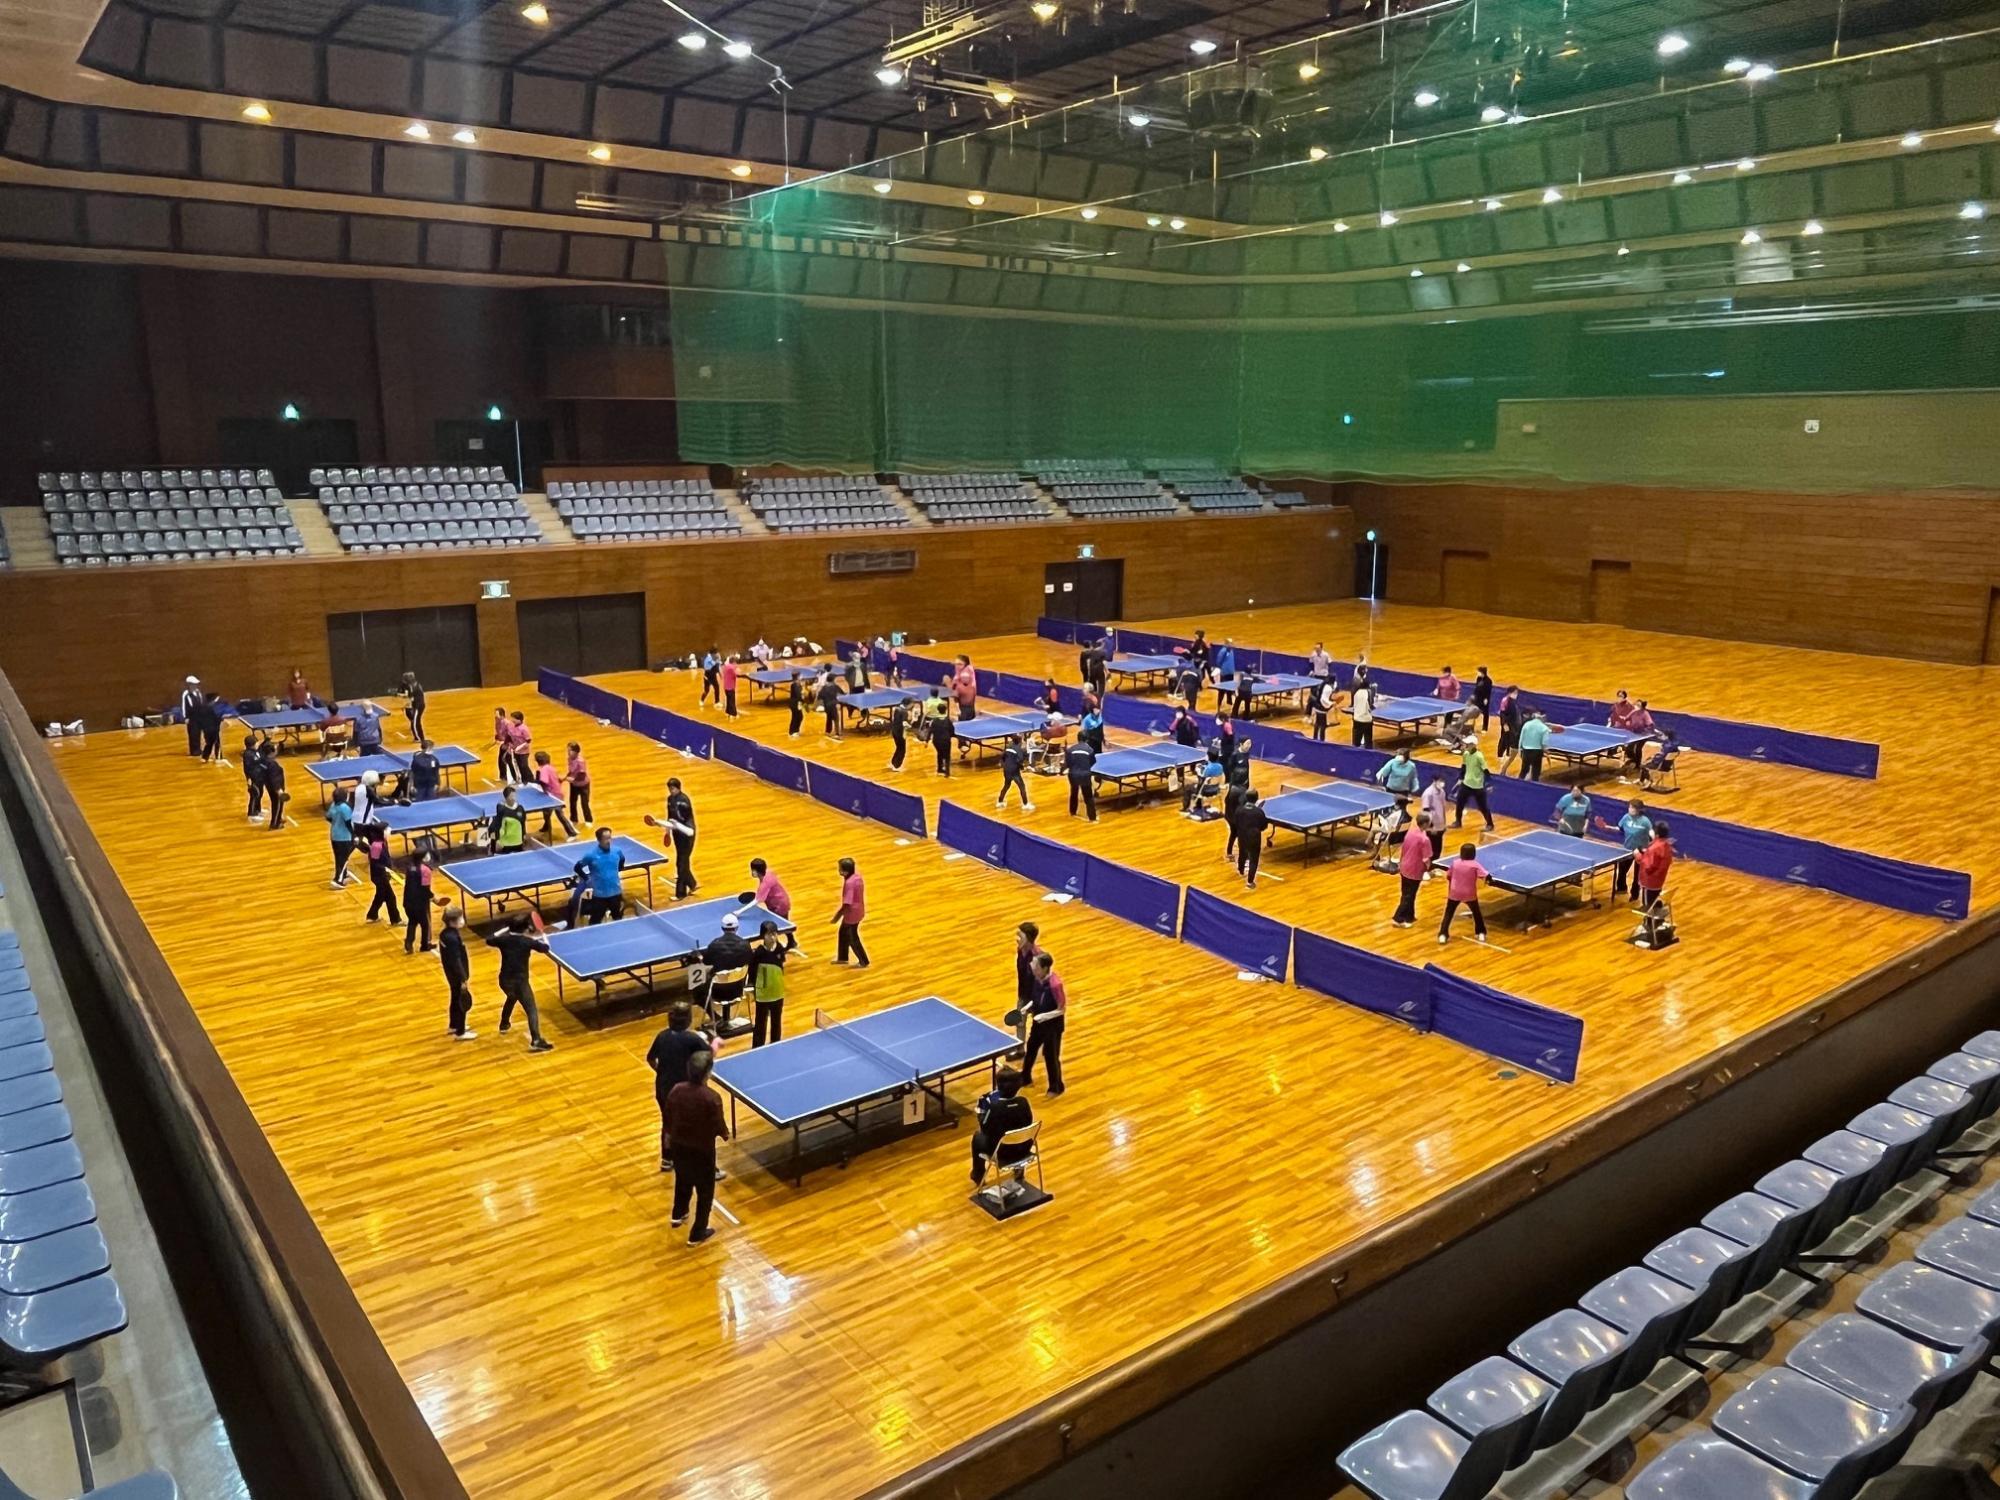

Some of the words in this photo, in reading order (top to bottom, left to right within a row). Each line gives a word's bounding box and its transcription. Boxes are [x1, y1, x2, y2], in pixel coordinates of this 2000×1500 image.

[480, 831, 488, 841] 4
[692, 969, 703, 984] 2
[910, 1100, 917, 1116] 1
